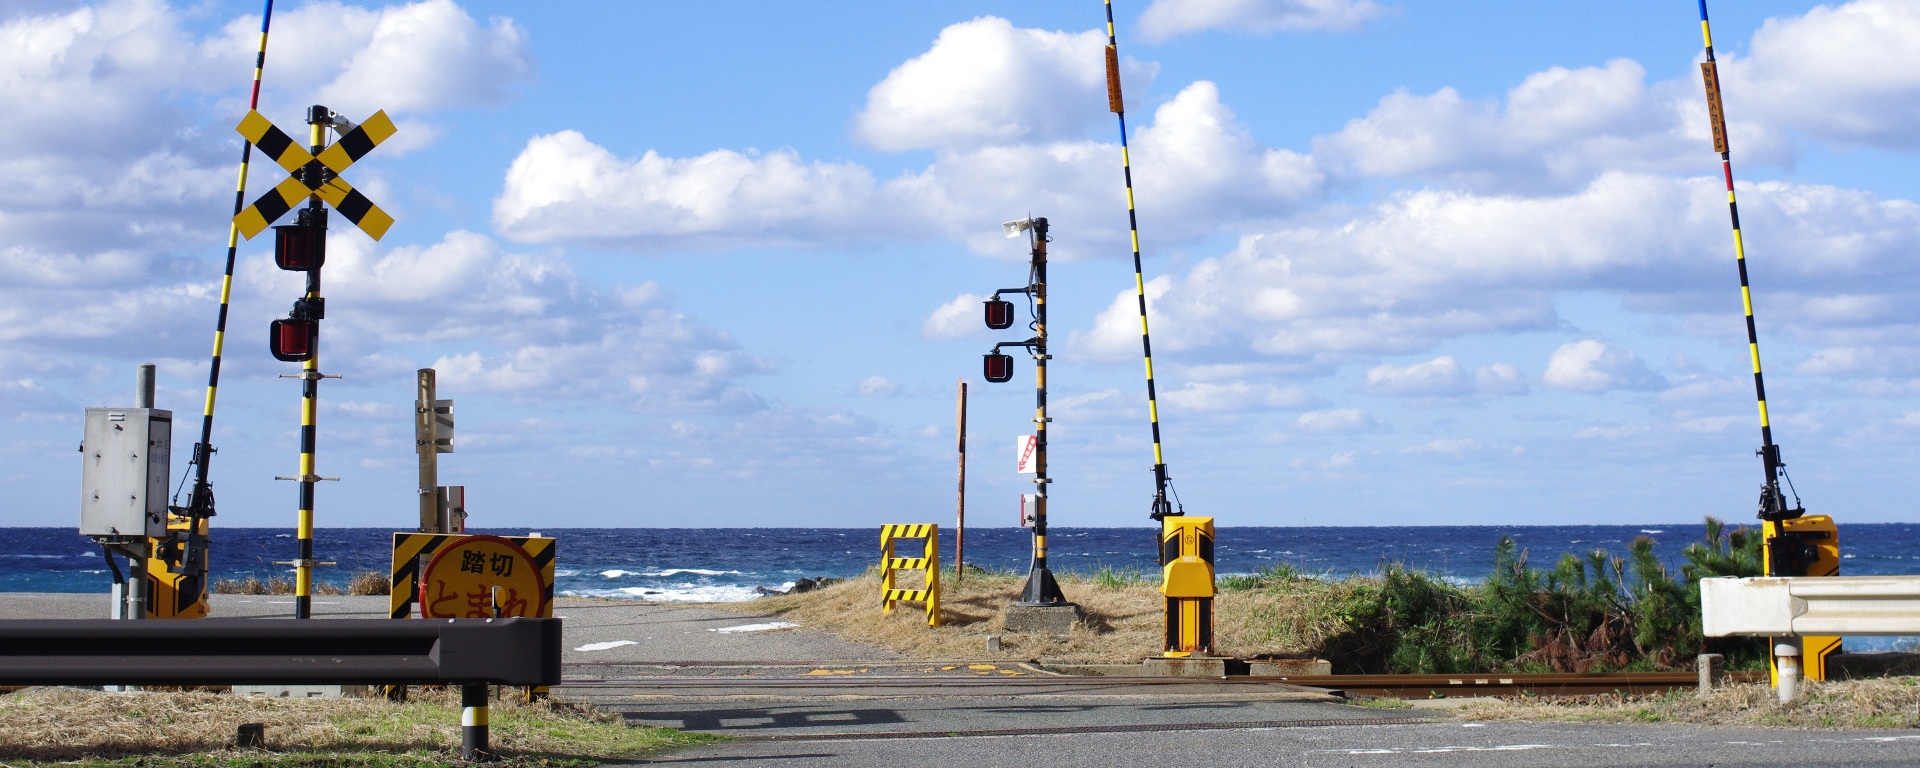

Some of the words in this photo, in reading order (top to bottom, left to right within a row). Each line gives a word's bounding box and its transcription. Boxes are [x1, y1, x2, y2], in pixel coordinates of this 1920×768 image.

[461, 550, 514, 577] 踏切
[430, 580, 528, 618] とまれ
